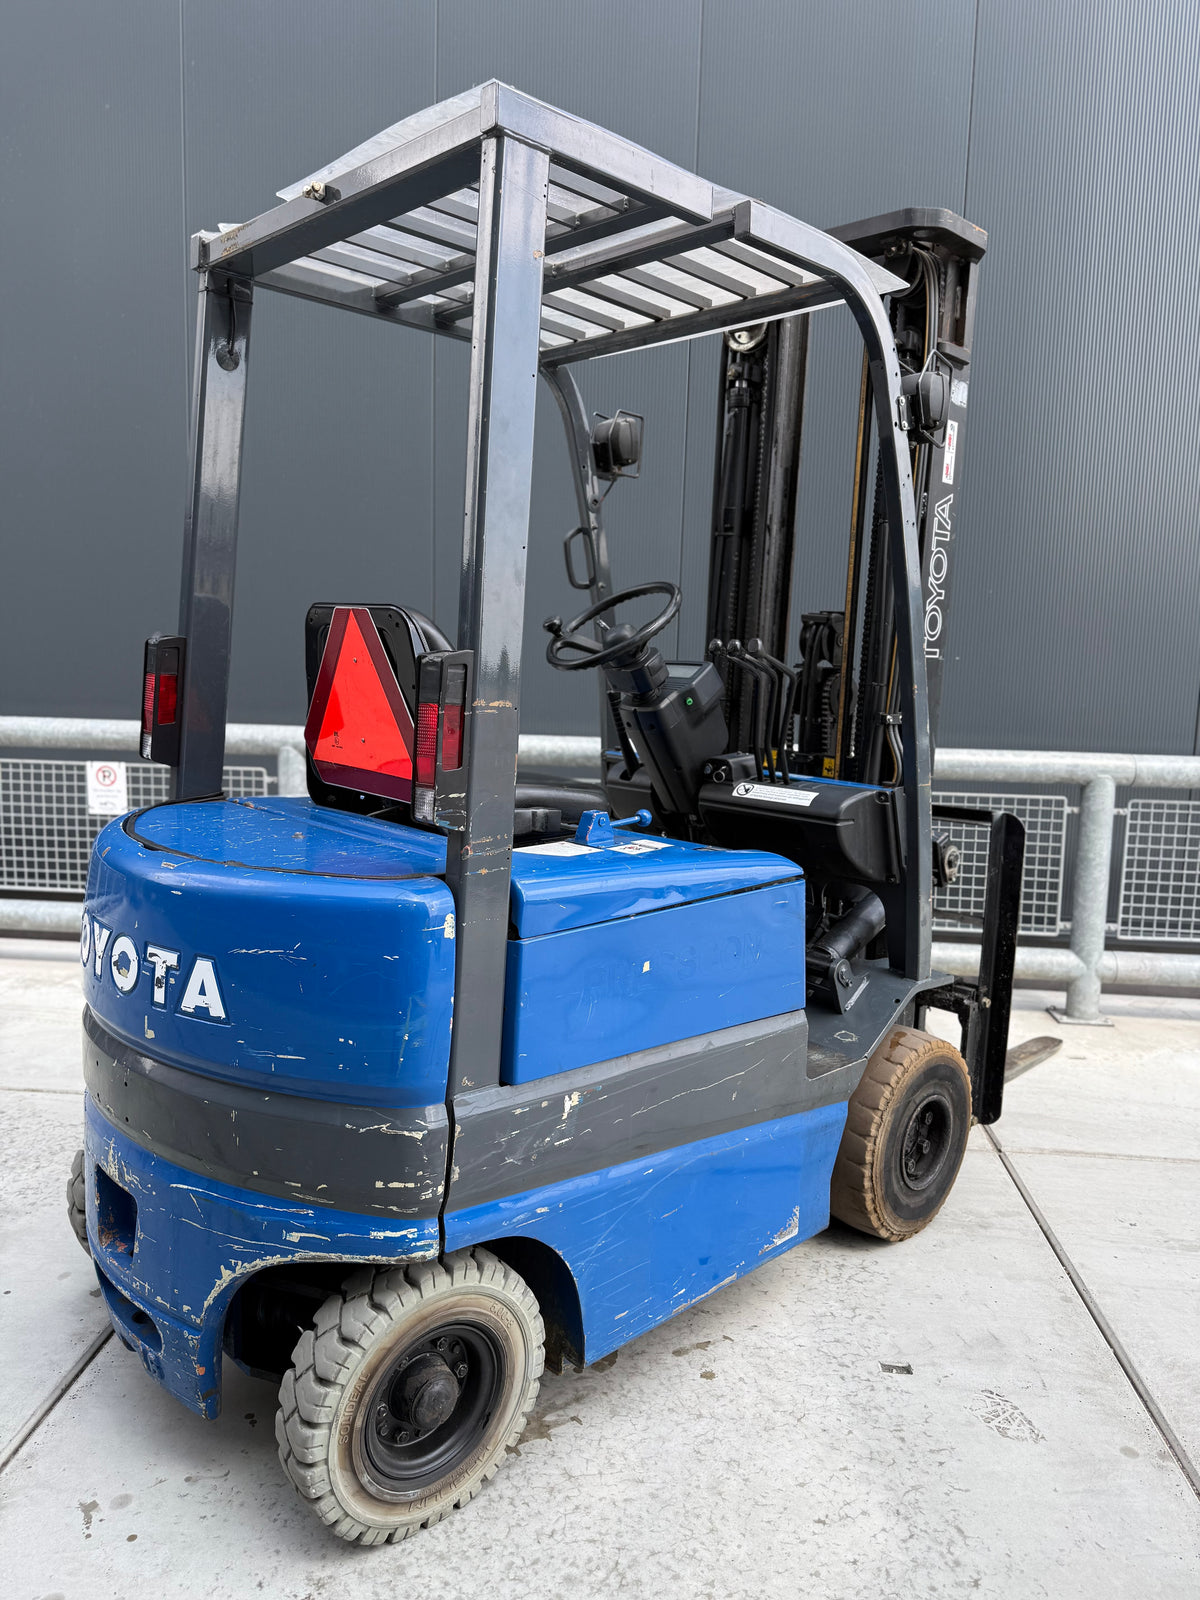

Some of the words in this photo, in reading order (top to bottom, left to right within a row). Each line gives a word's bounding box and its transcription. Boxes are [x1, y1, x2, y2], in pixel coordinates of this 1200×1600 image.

[101, 769, 112, 782] P
[81, 911, 227, 1020] OYOTA
[337, 1371, 371, 1446] SOLIDEAL
